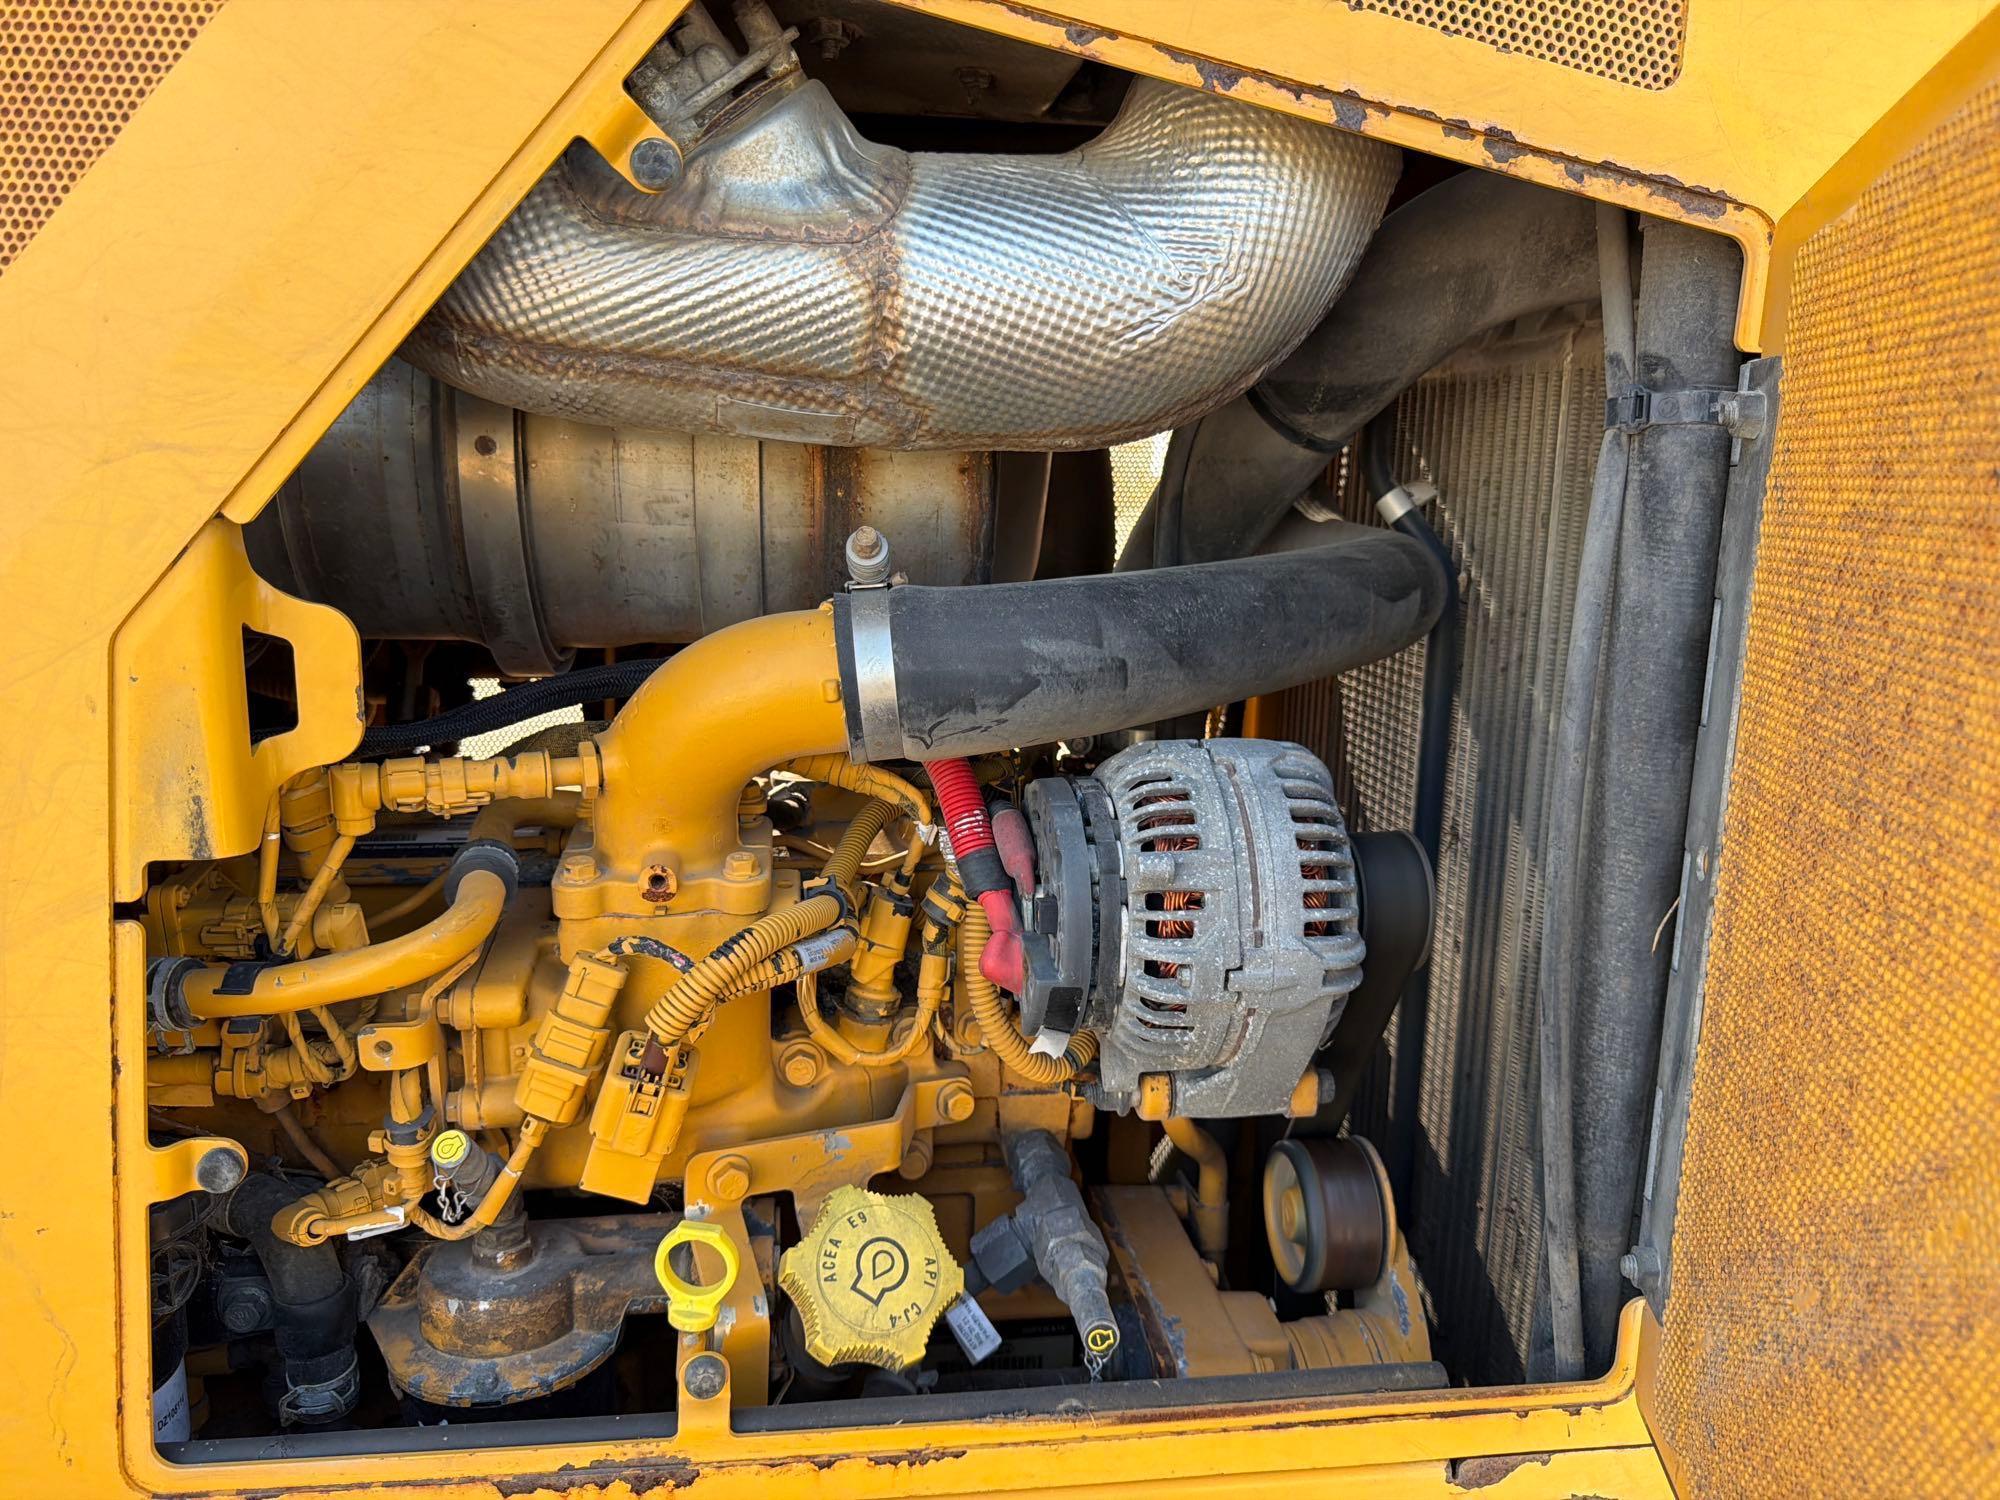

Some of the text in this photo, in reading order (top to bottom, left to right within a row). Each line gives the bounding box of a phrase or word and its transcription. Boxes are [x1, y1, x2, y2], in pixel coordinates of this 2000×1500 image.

[822, 1211, 868, 1283] ACEA E9
[889, 1257, 938, 1328] API CJ-4
